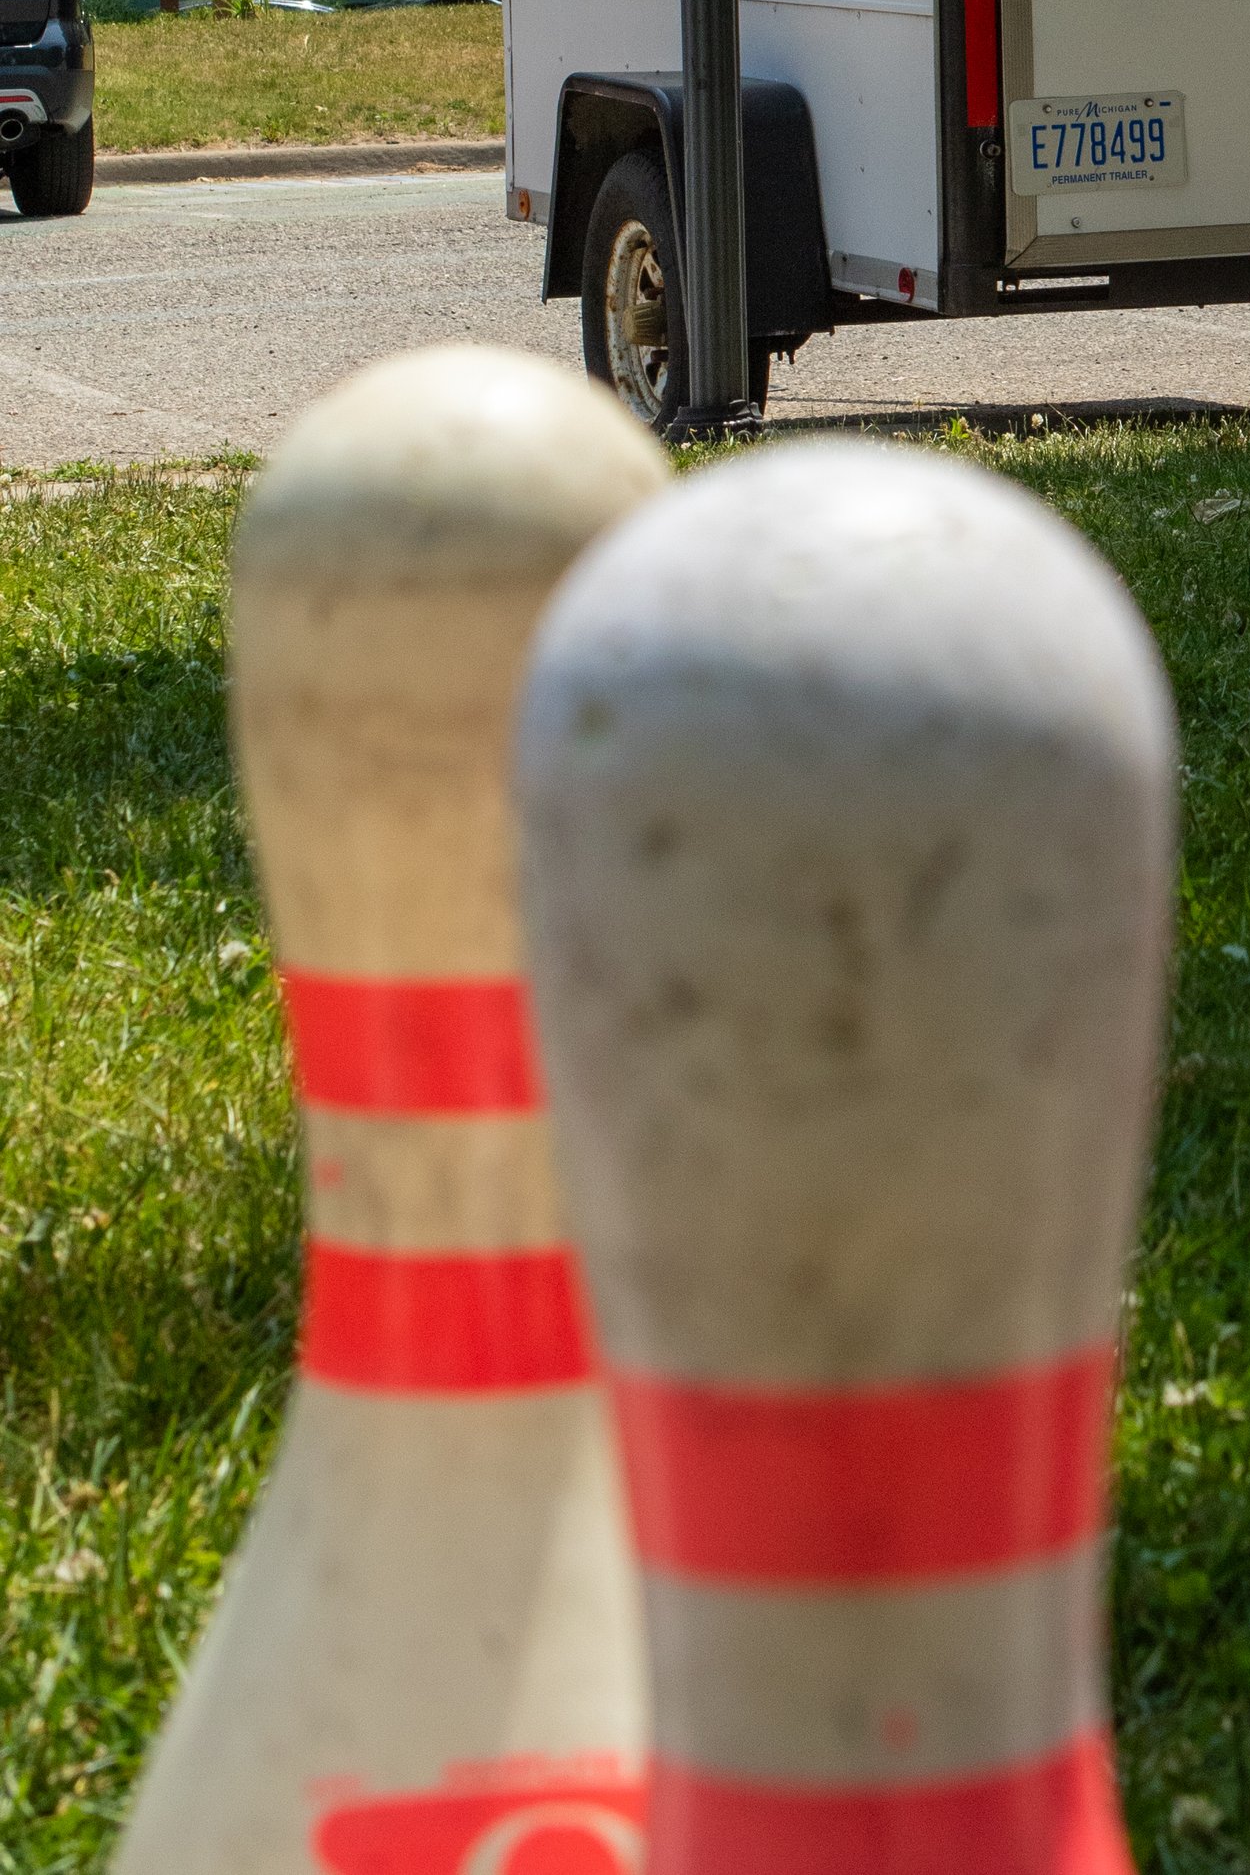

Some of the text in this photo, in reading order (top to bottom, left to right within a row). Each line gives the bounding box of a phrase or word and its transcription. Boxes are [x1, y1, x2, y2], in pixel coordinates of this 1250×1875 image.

[1057, 101, 1137, 121] PURE MICHIGAN
[1032, 118, 1165, 169] E778499
[1052, 171, 1148, 185] PERMANENT TRAILER
